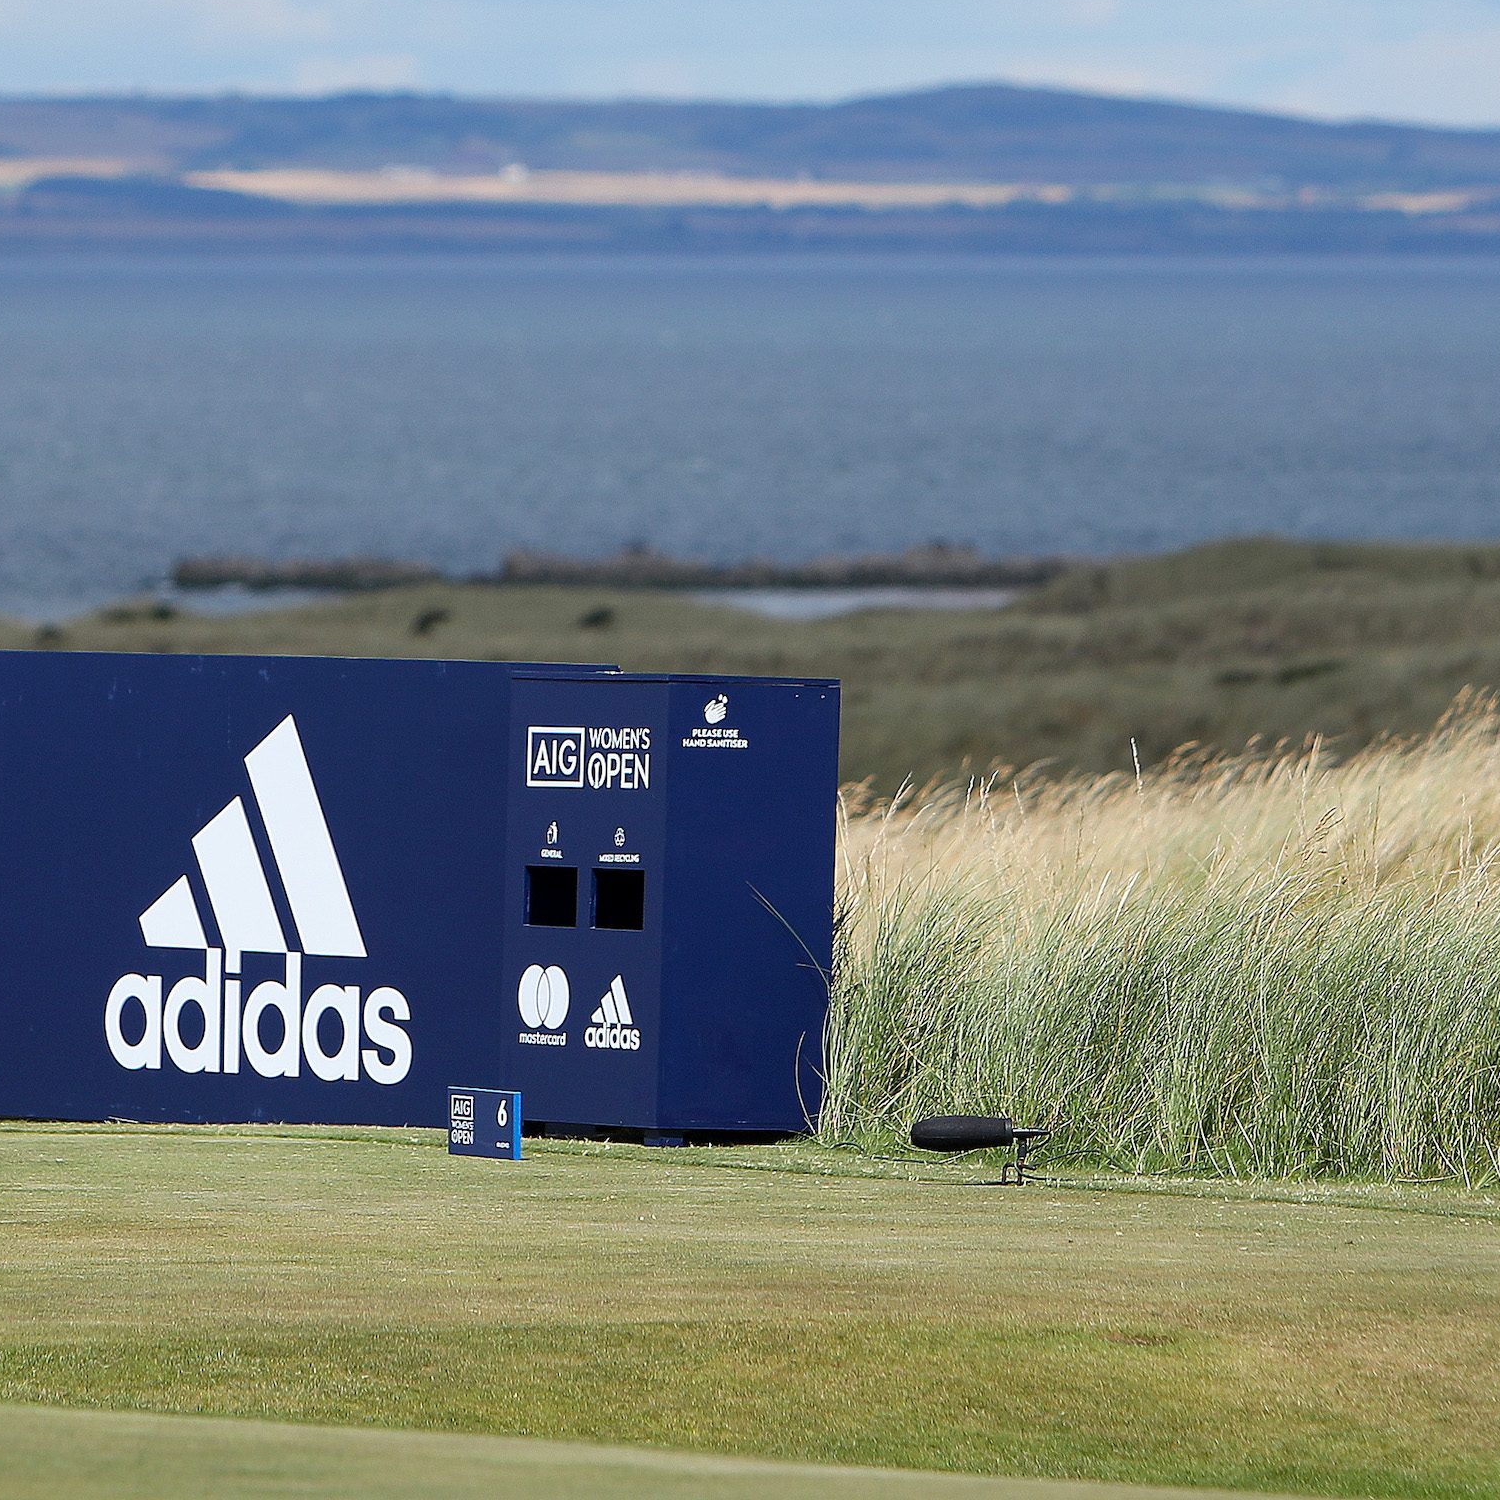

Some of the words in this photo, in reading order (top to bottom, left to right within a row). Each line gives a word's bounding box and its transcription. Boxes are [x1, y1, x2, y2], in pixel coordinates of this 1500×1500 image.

[588, 727, 651, 750] WOMEN'S
[682, 739, 706, 748] HAND
[706, 739, 749, 749] SANITISER
[692, 728, 722, 738] PLEASE
[722, 729, 739, 738] USE
[533, 739, 577, 776] AIG
[587, 752, 650, 790] OPEN
[104, 947, 412, 1085] adidas
[518, 1031, 567, 1046] mastercard
[584, 1021, 641, 1051] adidas
[453, 1099, 471, 1116] AIG
[497, 1099, 508, 1127] 6
[451, 1128, 474, 1145] OPEN
